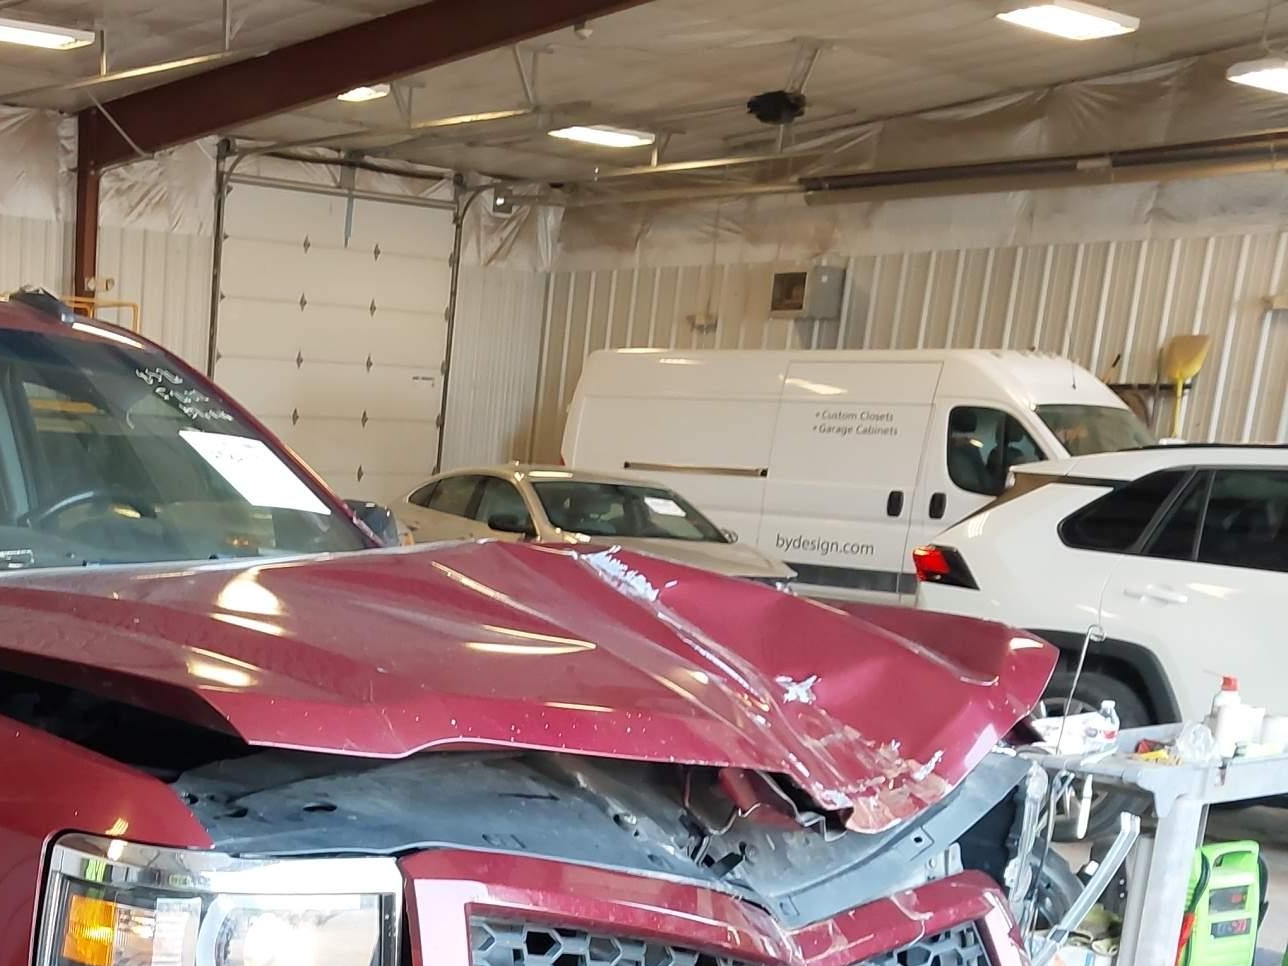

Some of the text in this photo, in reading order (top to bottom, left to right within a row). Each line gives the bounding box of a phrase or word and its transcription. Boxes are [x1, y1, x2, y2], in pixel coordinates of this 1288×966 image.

[822, 410, 894, 422] Custom Closets
[818, 423, 898, 436] Garage Cabinets
[775, 533, 874, 555] bydesign.com
